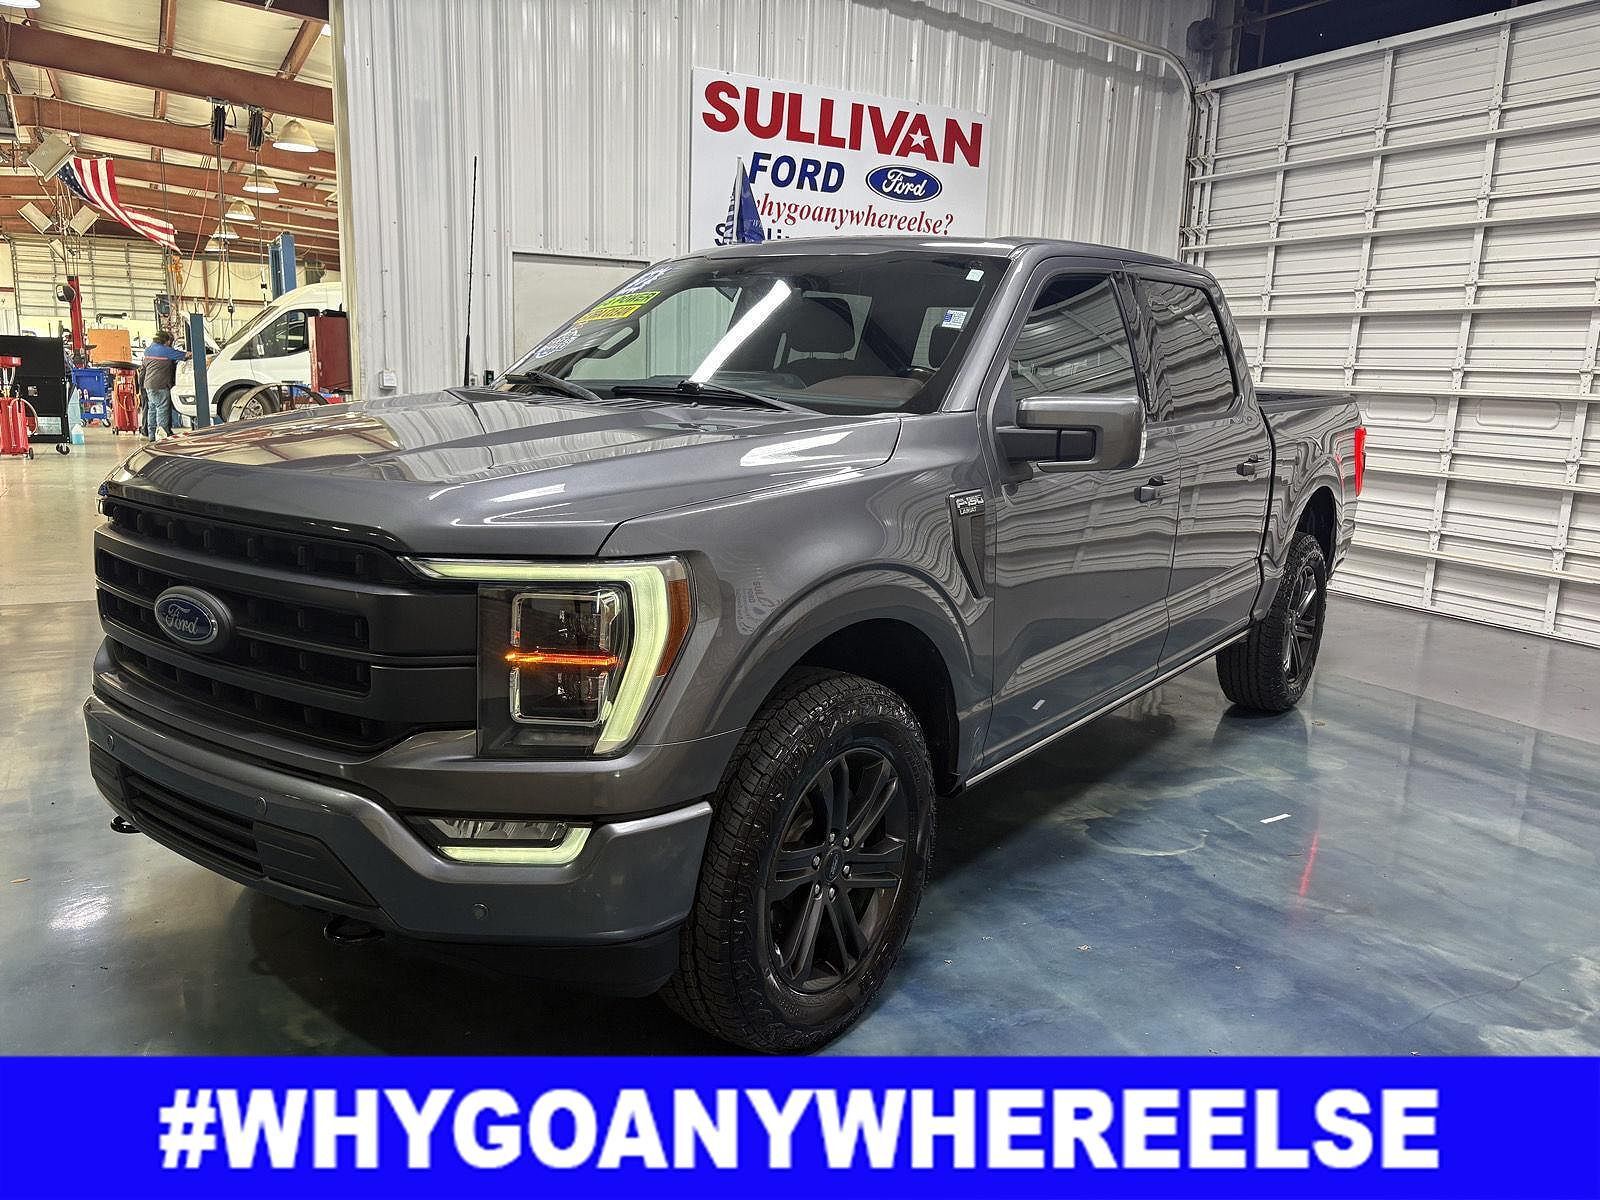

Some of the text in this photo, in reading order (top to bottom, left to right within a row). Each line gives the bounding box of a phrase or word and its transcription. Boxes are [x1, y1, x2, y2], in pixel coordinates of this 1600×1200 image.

[702, 80, 983, 168] SULLIVAN
[749, 152, 845, 193] FORD
[756, 193, 954, 235] hygoanywhereelse?
